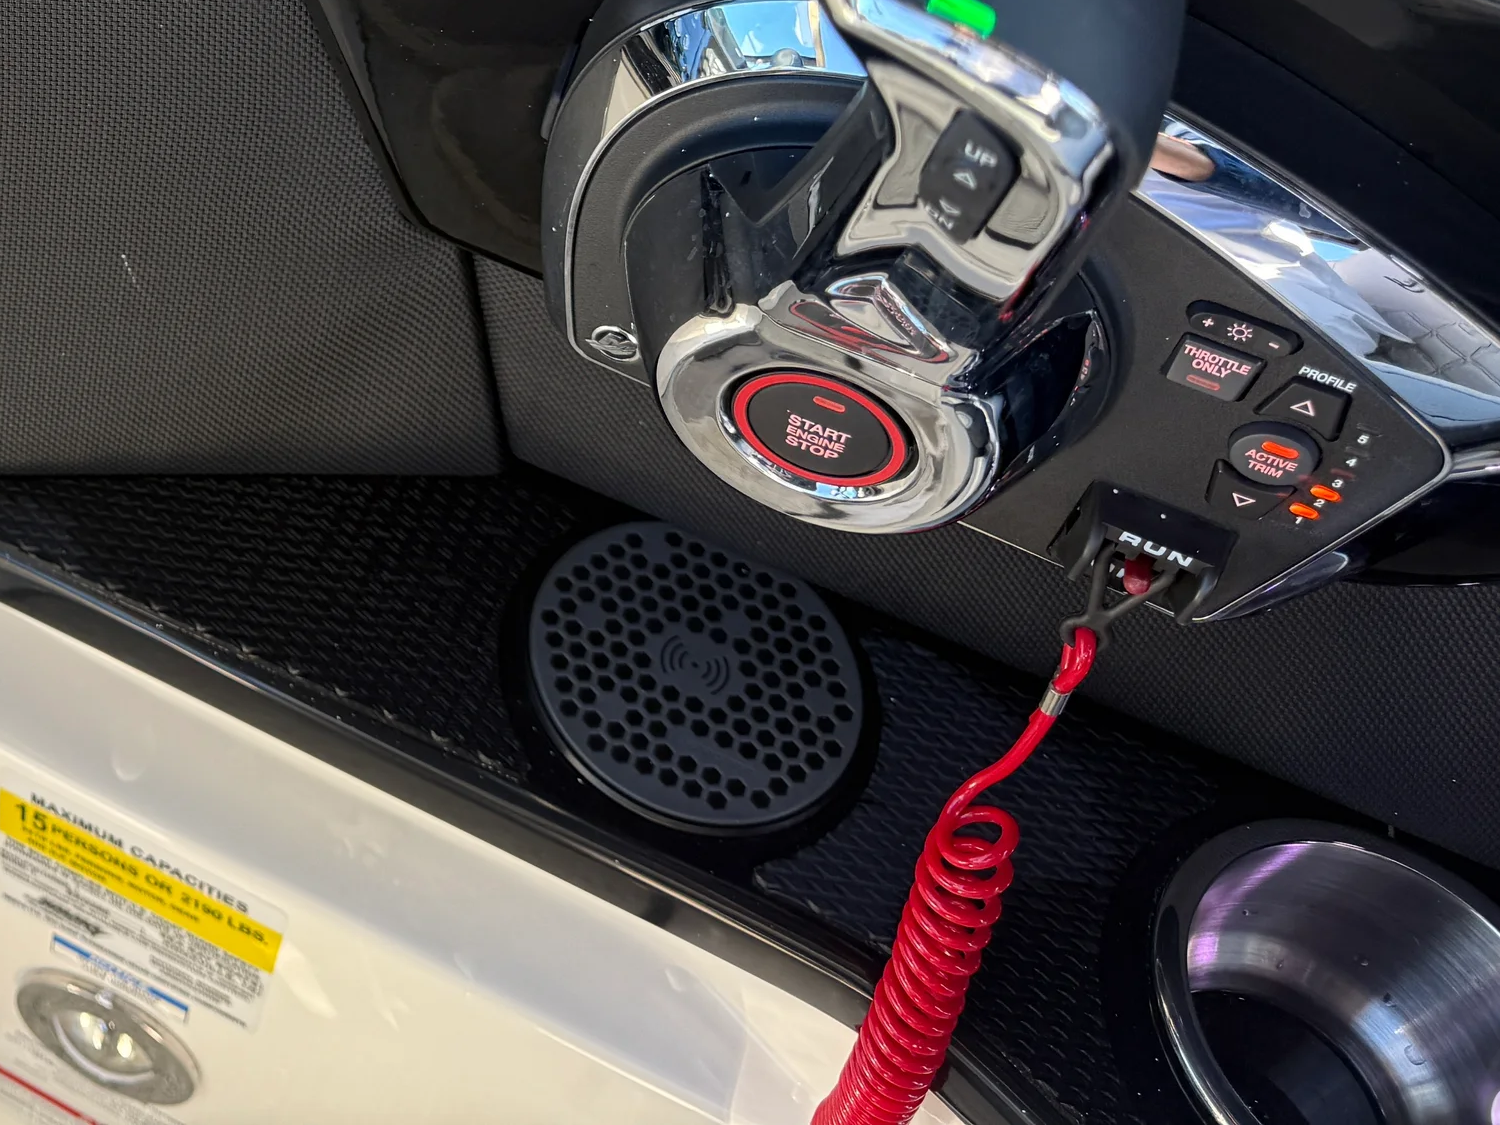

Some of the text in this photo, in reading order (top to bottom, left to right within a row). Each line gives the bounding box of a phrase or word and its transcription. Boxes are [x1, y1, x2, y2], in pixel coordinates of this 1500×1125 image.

[964, 138, 998, 168] UP
[1183, 343, 1252, 377] THROTTLE
[1191, 358, 1232, 379] ONLY
[1298, 365, 1358, 394] PROFILE
[786, 425, 846, 454] ENGINE
[787, 413, 852, 444] START
[1357, 434, 1369, 445] 5
[784, 435, 840, 460] STOP
[1245, 448, 1299, 473] ACTIVE
[1248, 459, 1284, 479] TRIM
[1345, 457, 1358, 468] 4
[1331, 478, 1344, 489] 3
[1313, 498, 1325, 508] 2
[1294, 516, 1304, 525] 1
[1118, 530, 1194, 567] RUN
[15, 802, 49, 832] 15
[51, 822, 138, 877] PERSONS
[145, 873, 173, 895] OR
[30, 791, 124, 849] MAXIMUM
[129, 845, 250, 914] CAPACITIES
